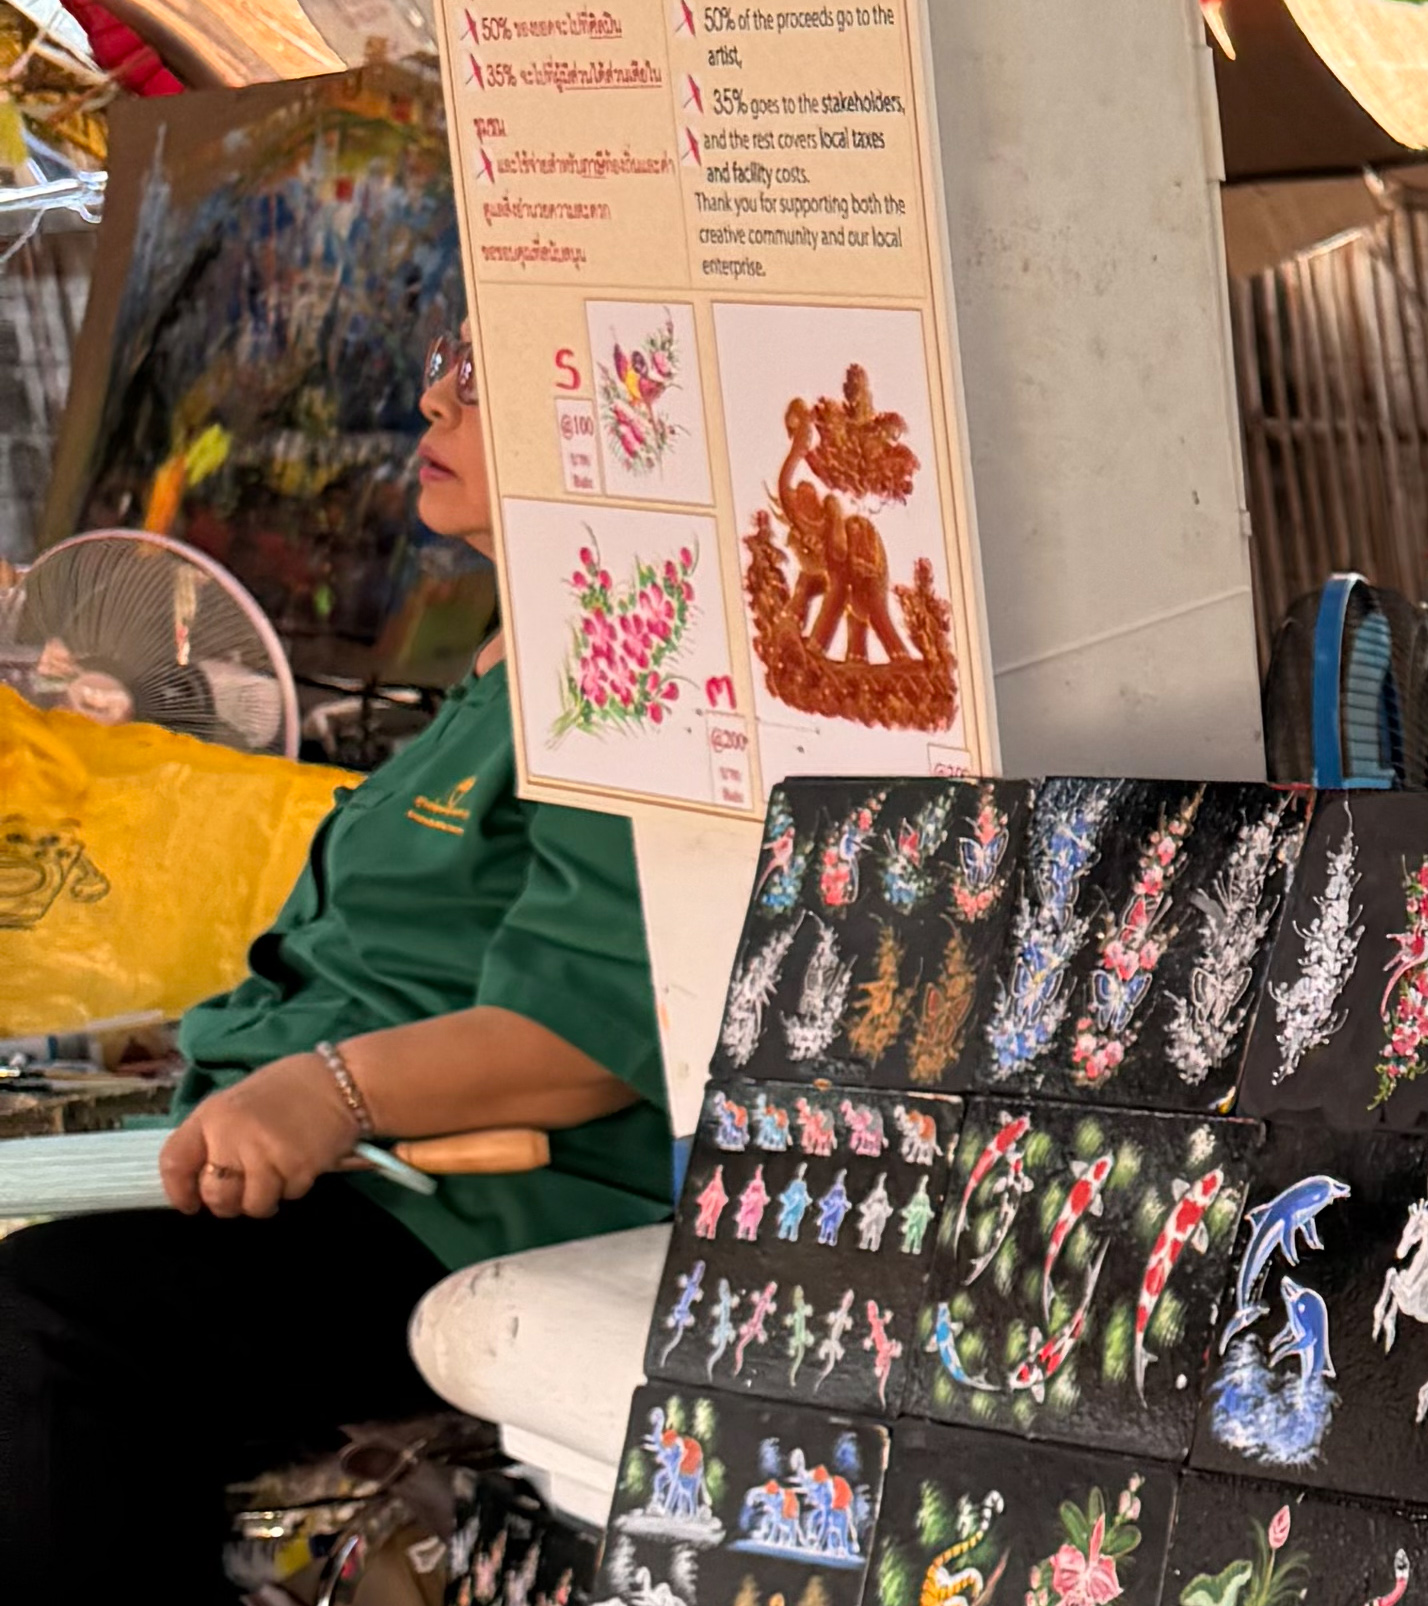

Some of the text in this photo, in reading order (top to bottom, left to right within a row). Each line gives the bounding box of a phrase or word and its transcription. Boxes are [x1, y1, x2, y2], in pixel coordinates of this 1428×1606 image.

[481, 17, 513, 41] 50%
[704, 4, 895, 34] 50% of the proceeds go to the
[708, 46, 742, 69] artist,
[486, 63, 517, 87] 35%
[713, 88, 905, 119] 35% goes to the stakeholders,
[704, 127, 885, 150] and the rest covers local taxes
[707, 161, 810, 189] and facility costs.
[695, 192, 906, 219] Thank you for supporting both the
[700, 226, 903, 251] creative community and our local
[702, 257, 766, 280] enterprise.
[555, 348, 581, 390] S
[561, 414, 594, 440] @100
[705, 676, 737, 709] M
